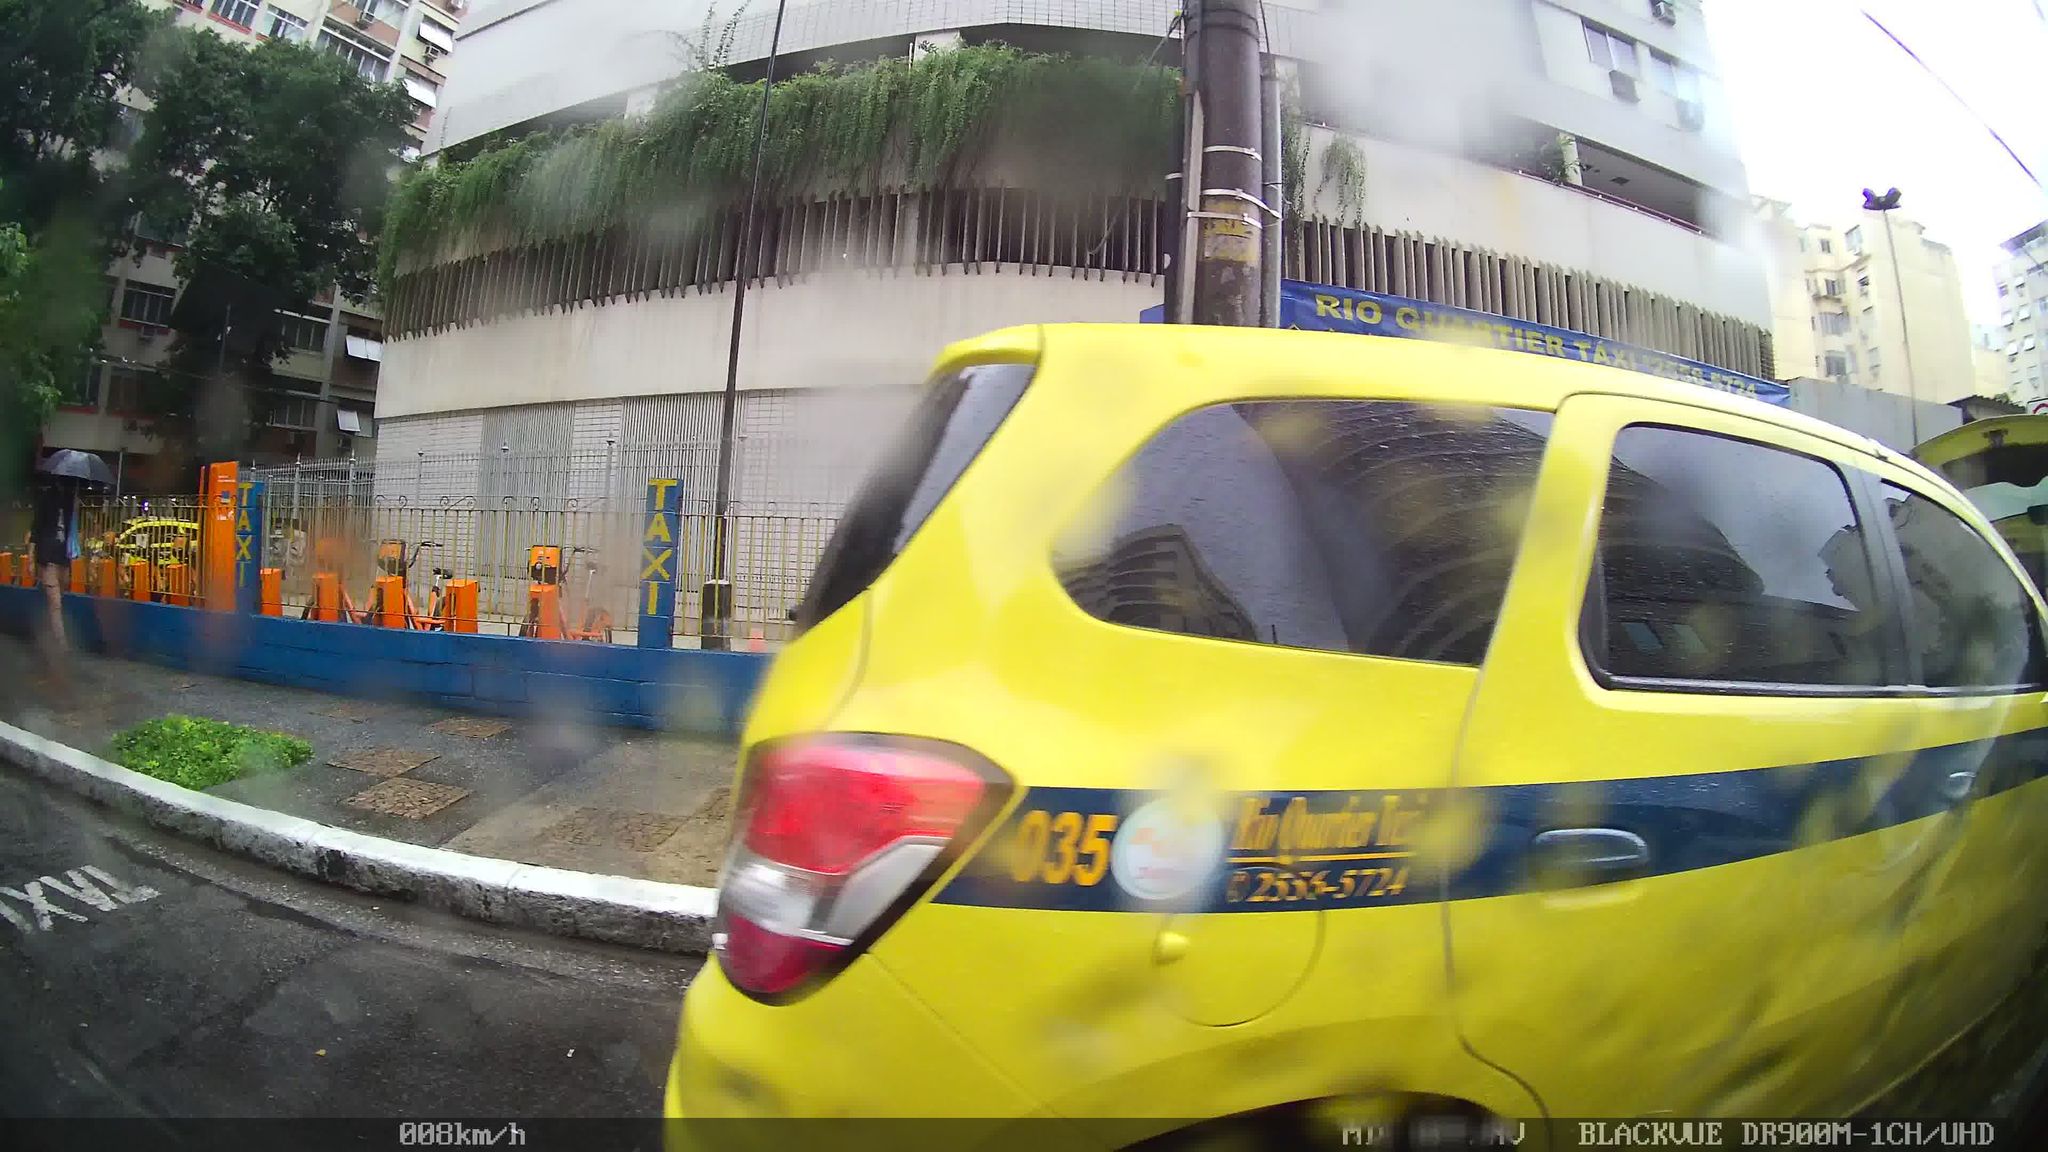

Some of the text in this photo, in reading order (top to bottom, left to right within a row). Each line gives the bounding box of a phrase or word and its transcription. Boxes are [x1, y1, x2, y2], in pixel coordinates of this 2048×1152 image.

[1315, 294, 1382, 325] RIO
[235, 483, 254, 587] TAXI
[641, 479, 678, 615] TAXI
